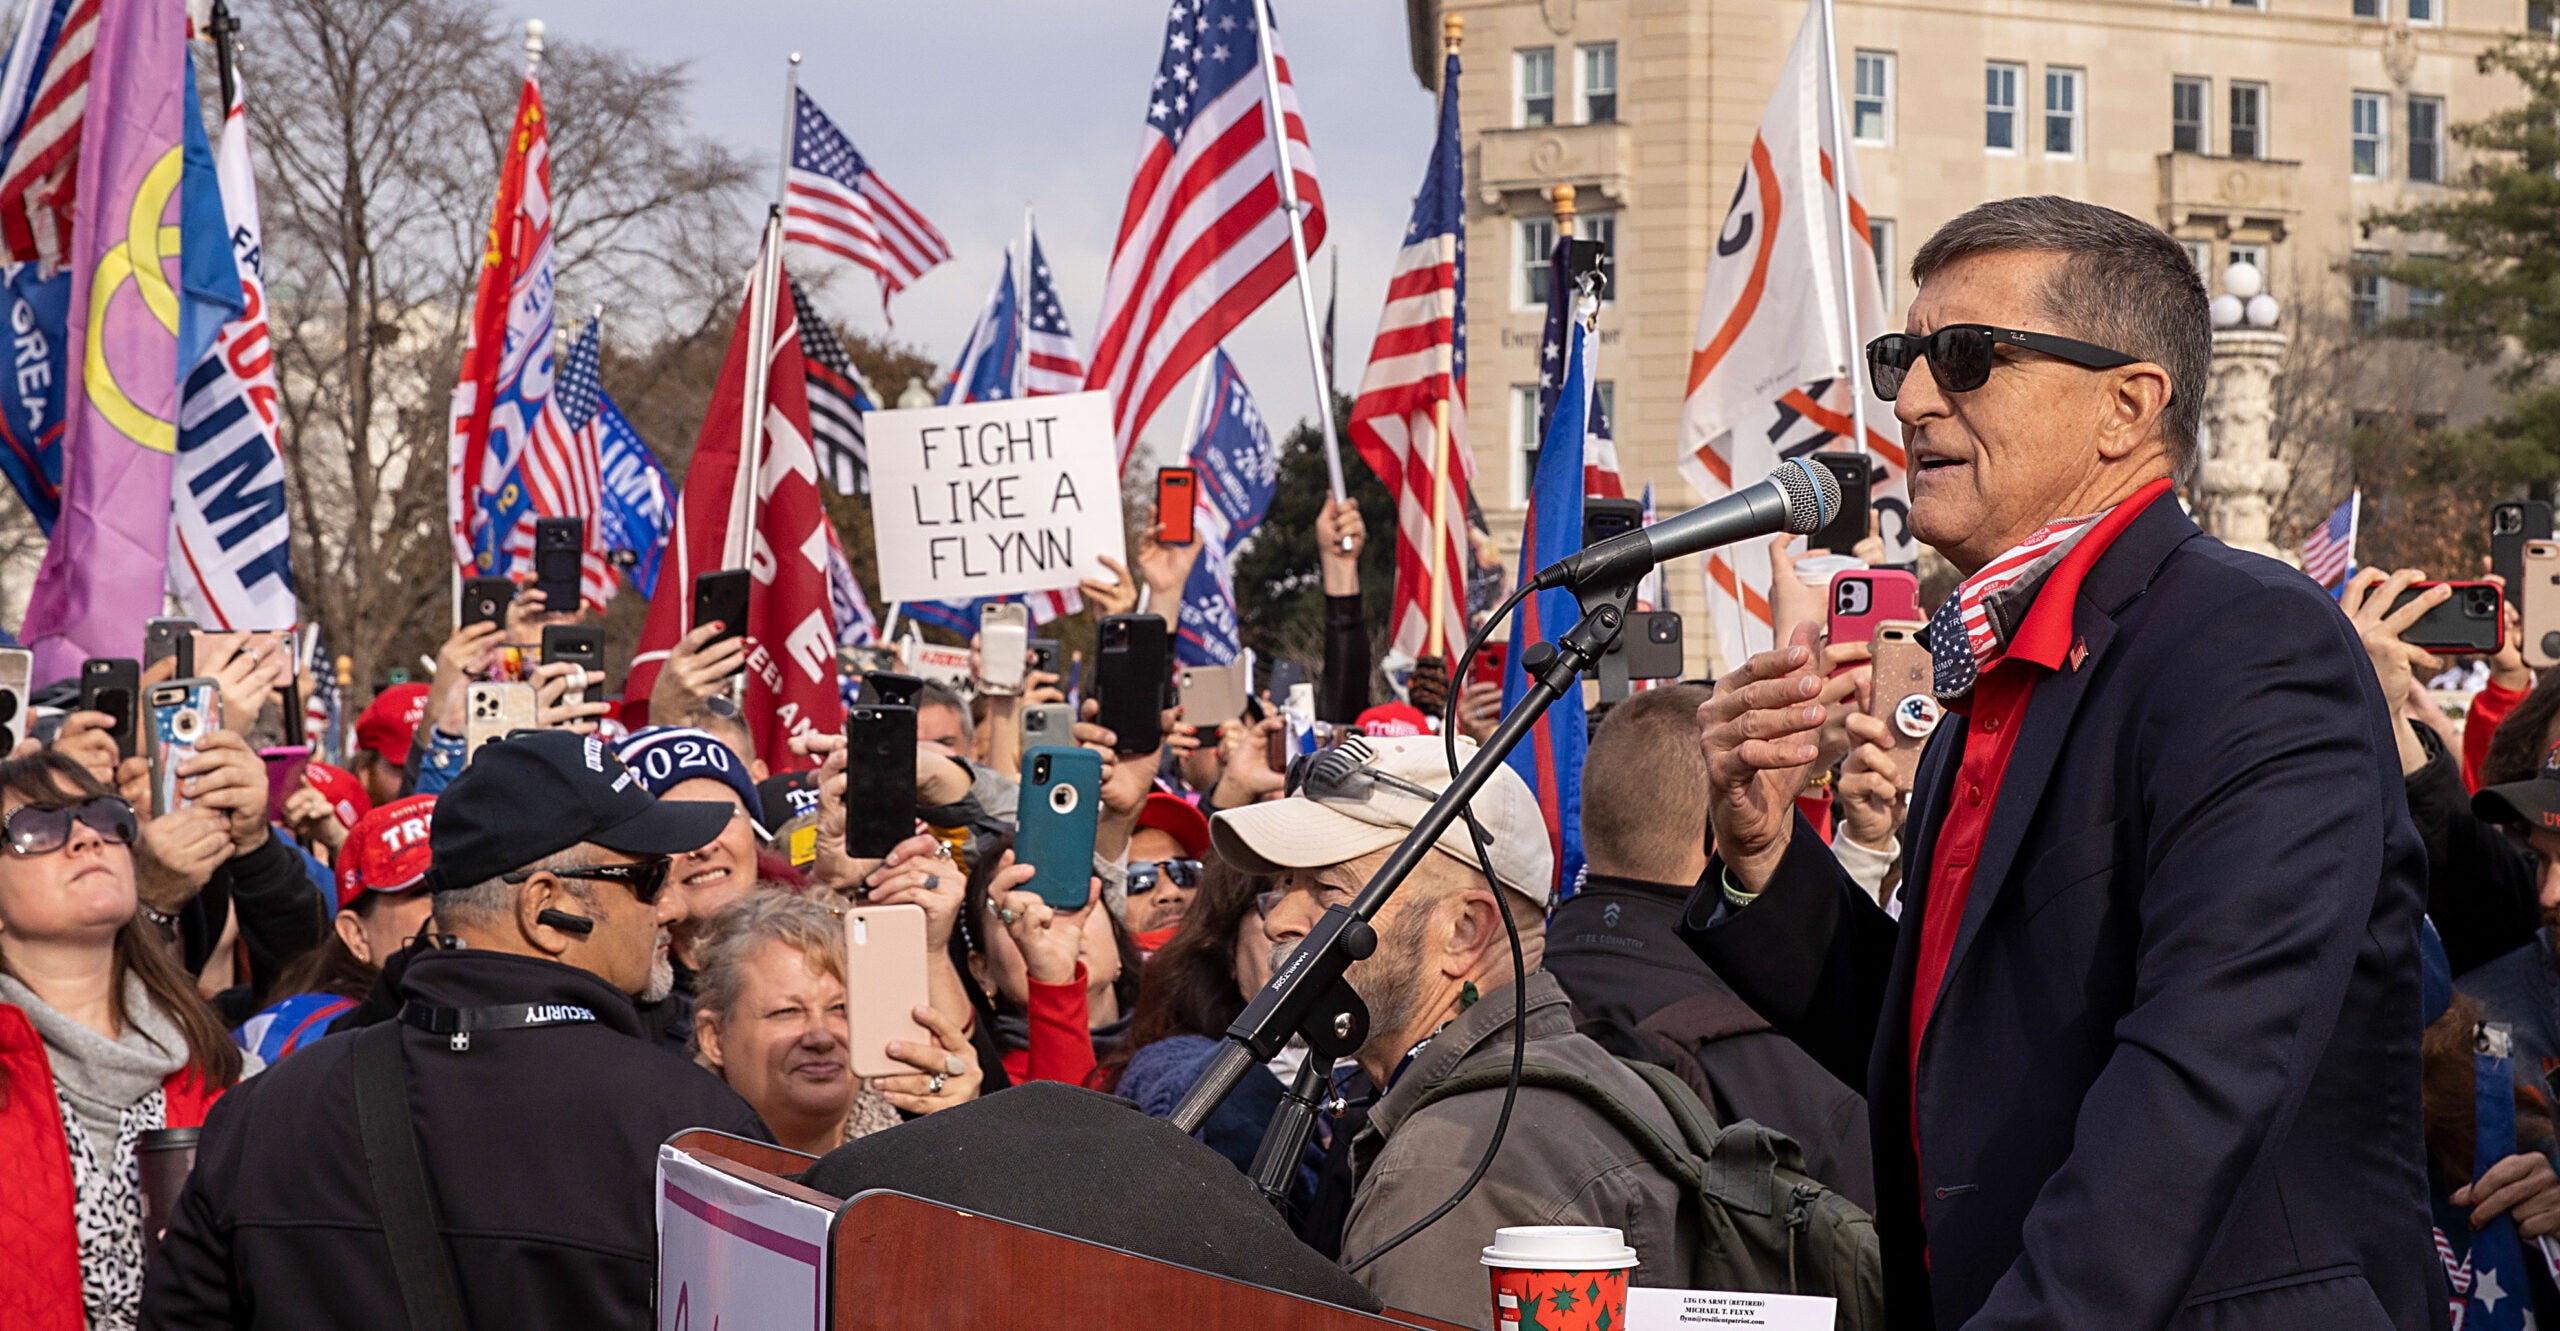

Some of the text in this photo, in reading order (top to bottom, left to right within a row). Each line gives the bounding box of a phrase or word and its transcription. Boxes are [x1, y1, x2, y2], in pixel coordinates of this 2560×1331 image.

[921, 417, 1058, 470] FIGHT
[912, 471, 1083, 525] LIKE A
[930, 527, 1072, 580] FLYNN
[1273, 951, 1309, 991] HAMILTON
[525, 1005, 596, 1023] SECURITY
[1685, 1307, 1720, 1315] MICHAEL
[1729, 1299, 1765, 1307] (RETIRED)
[1680, 1314, 1765, 1325] flynn@resilientpatriot.com
